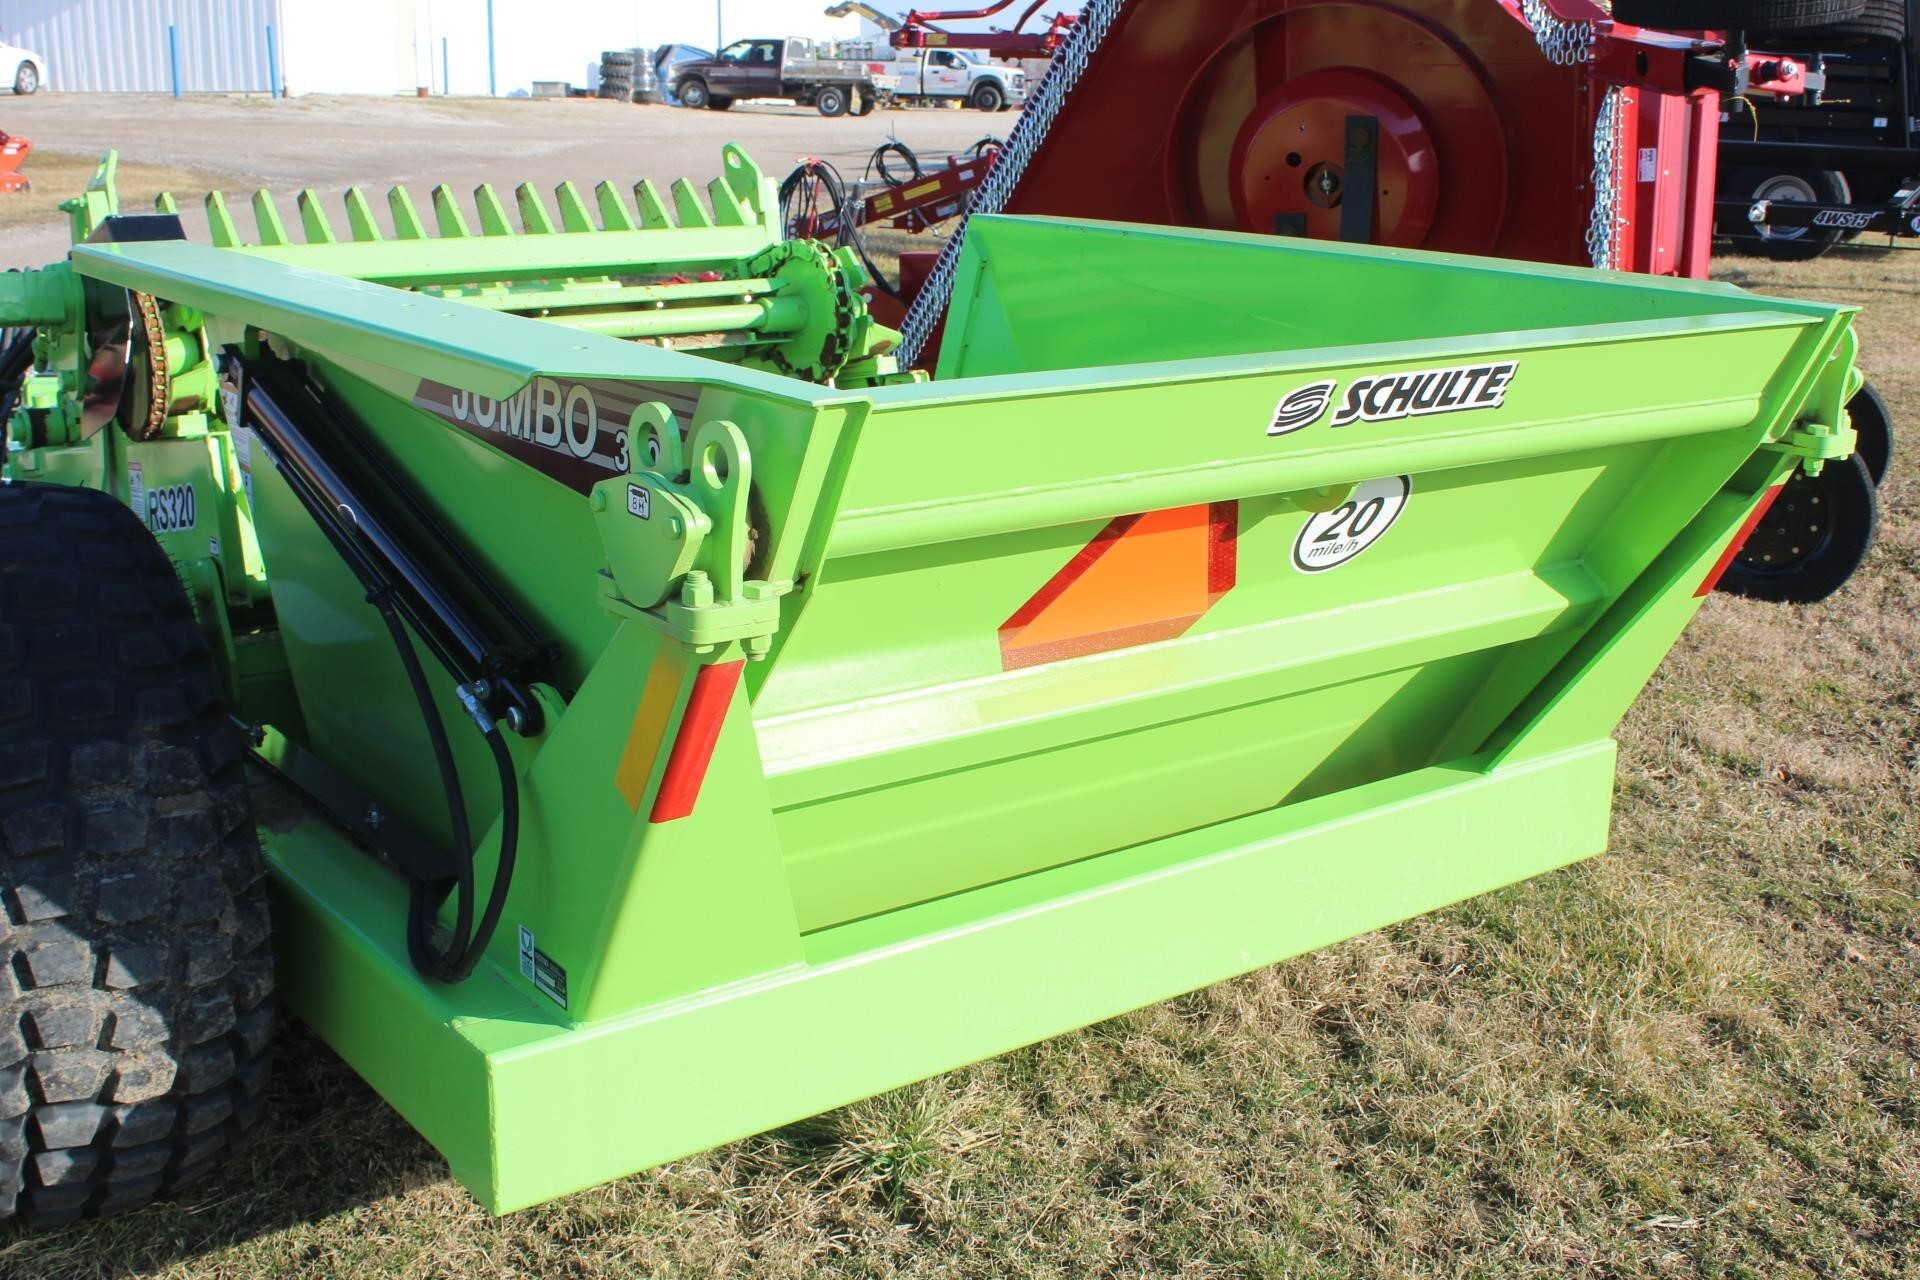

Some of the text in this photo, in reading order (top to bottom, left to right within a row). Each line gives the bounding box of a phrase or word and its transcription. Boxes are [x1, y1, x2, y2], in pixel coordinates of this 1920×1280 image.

[1813, 210, 1873, 228] 4WS15
[1333, 363, 1515, 422] SCHULTE
[149, 484, 195, 530] RS320
[1312, 496, 1385, 543] 20
[1307, 539, 1359, 559] mile/h
